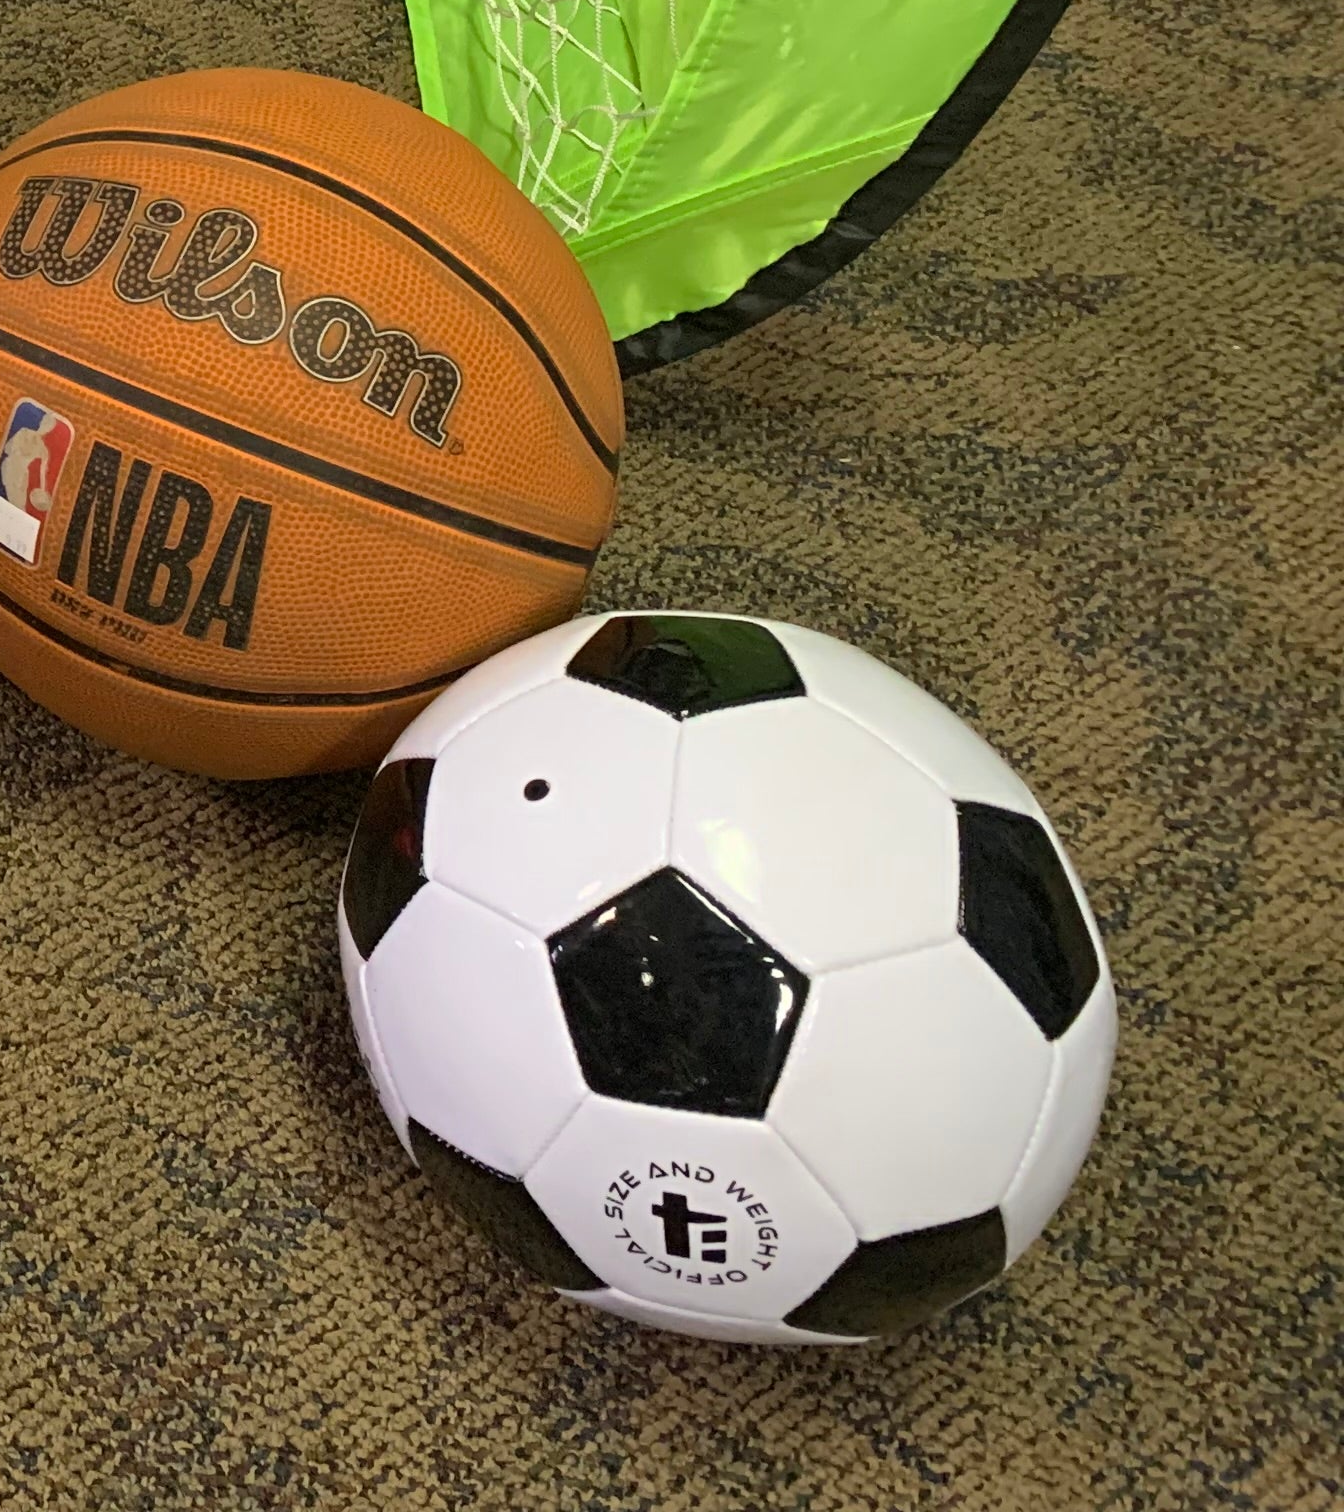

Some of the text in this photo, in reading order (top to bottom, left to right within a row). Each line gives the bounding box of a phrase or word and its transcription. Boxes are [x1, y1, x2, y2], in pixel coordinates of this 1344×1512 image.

[57, 439, 273, 652] NBA
[604, 1161, 779, 1286] OFFICIAL SIZE AND WEIGHT
